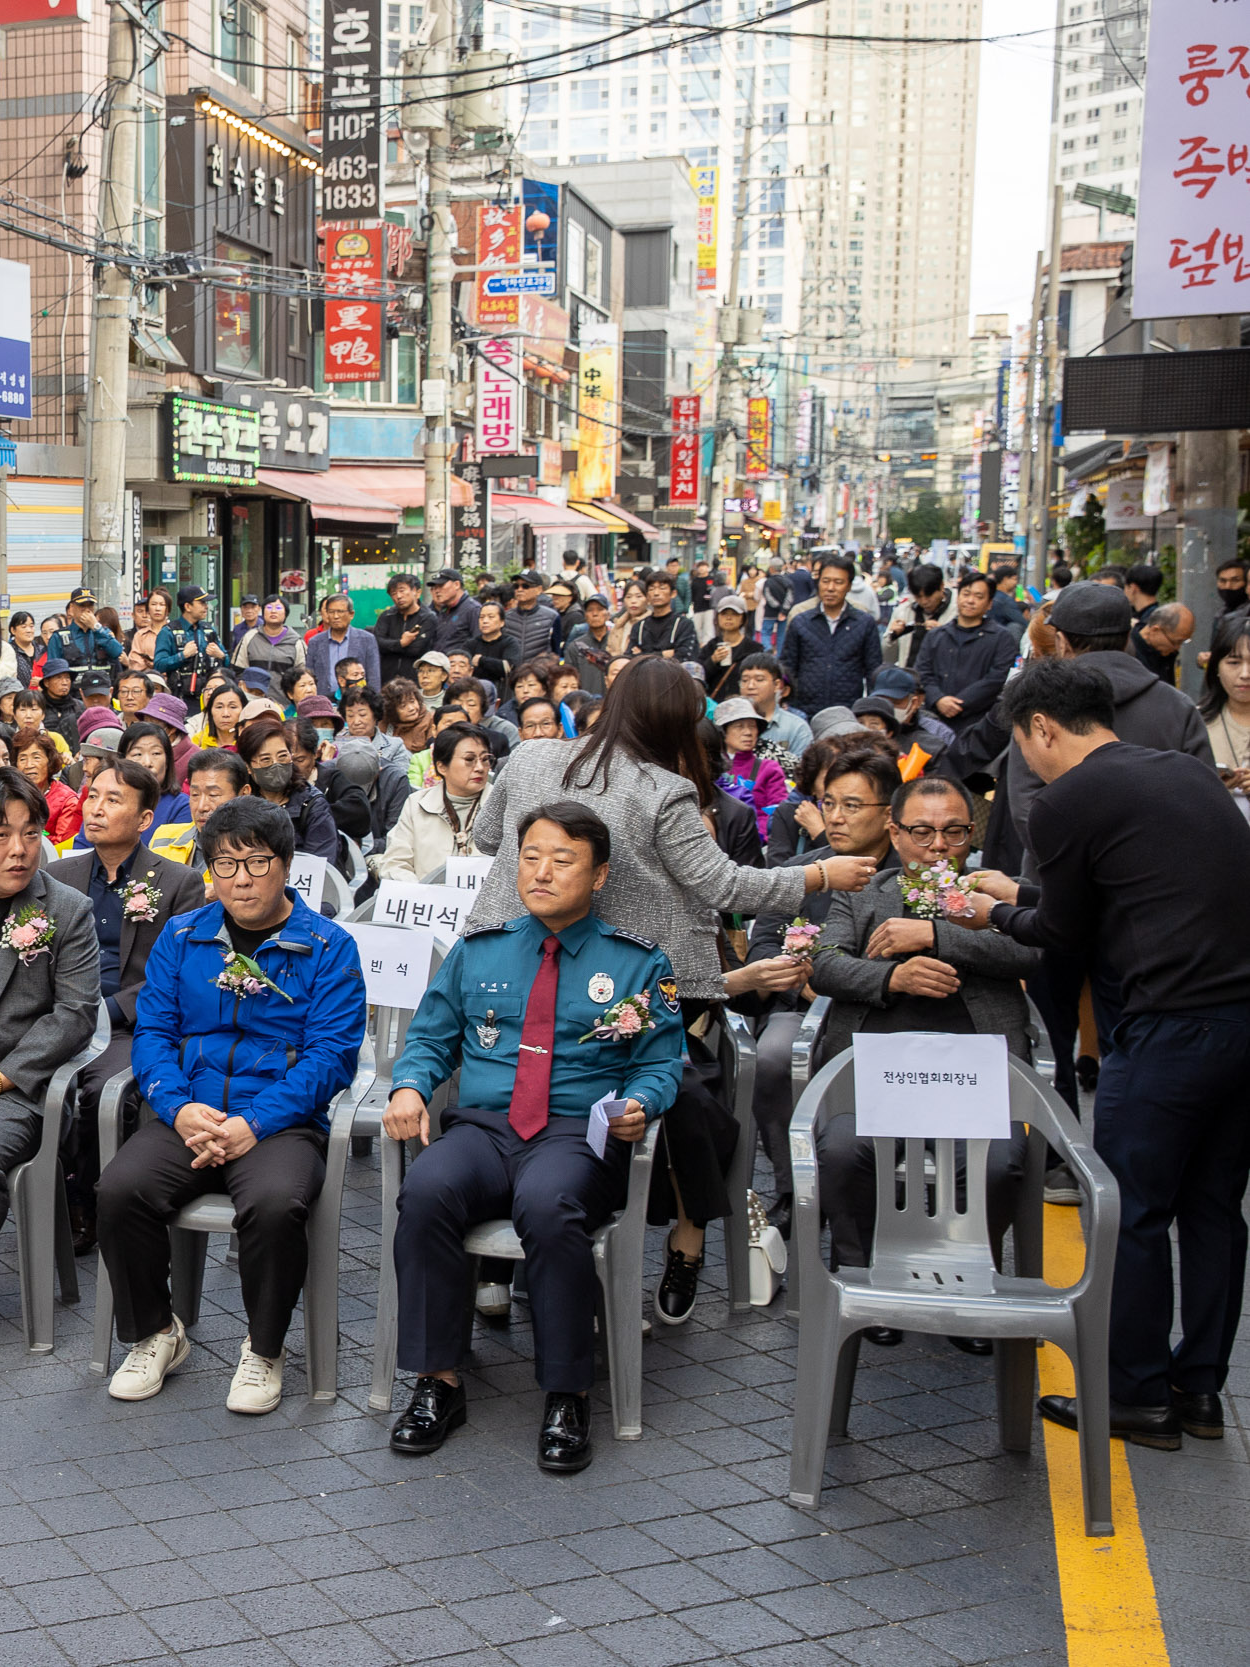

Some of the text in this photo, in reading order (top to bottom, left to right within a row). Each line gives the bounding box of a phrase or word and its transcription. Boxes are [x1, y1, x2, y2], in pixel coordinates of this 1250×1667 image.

[328, 112, 375, 141] HOF
[324, 155, 378, 181] 463-
[324, 183, 376, 210] 1833
[385, 898, 459, 932] 내빈석
[883, 1070, 979, 1086] 전상인협회회장님
